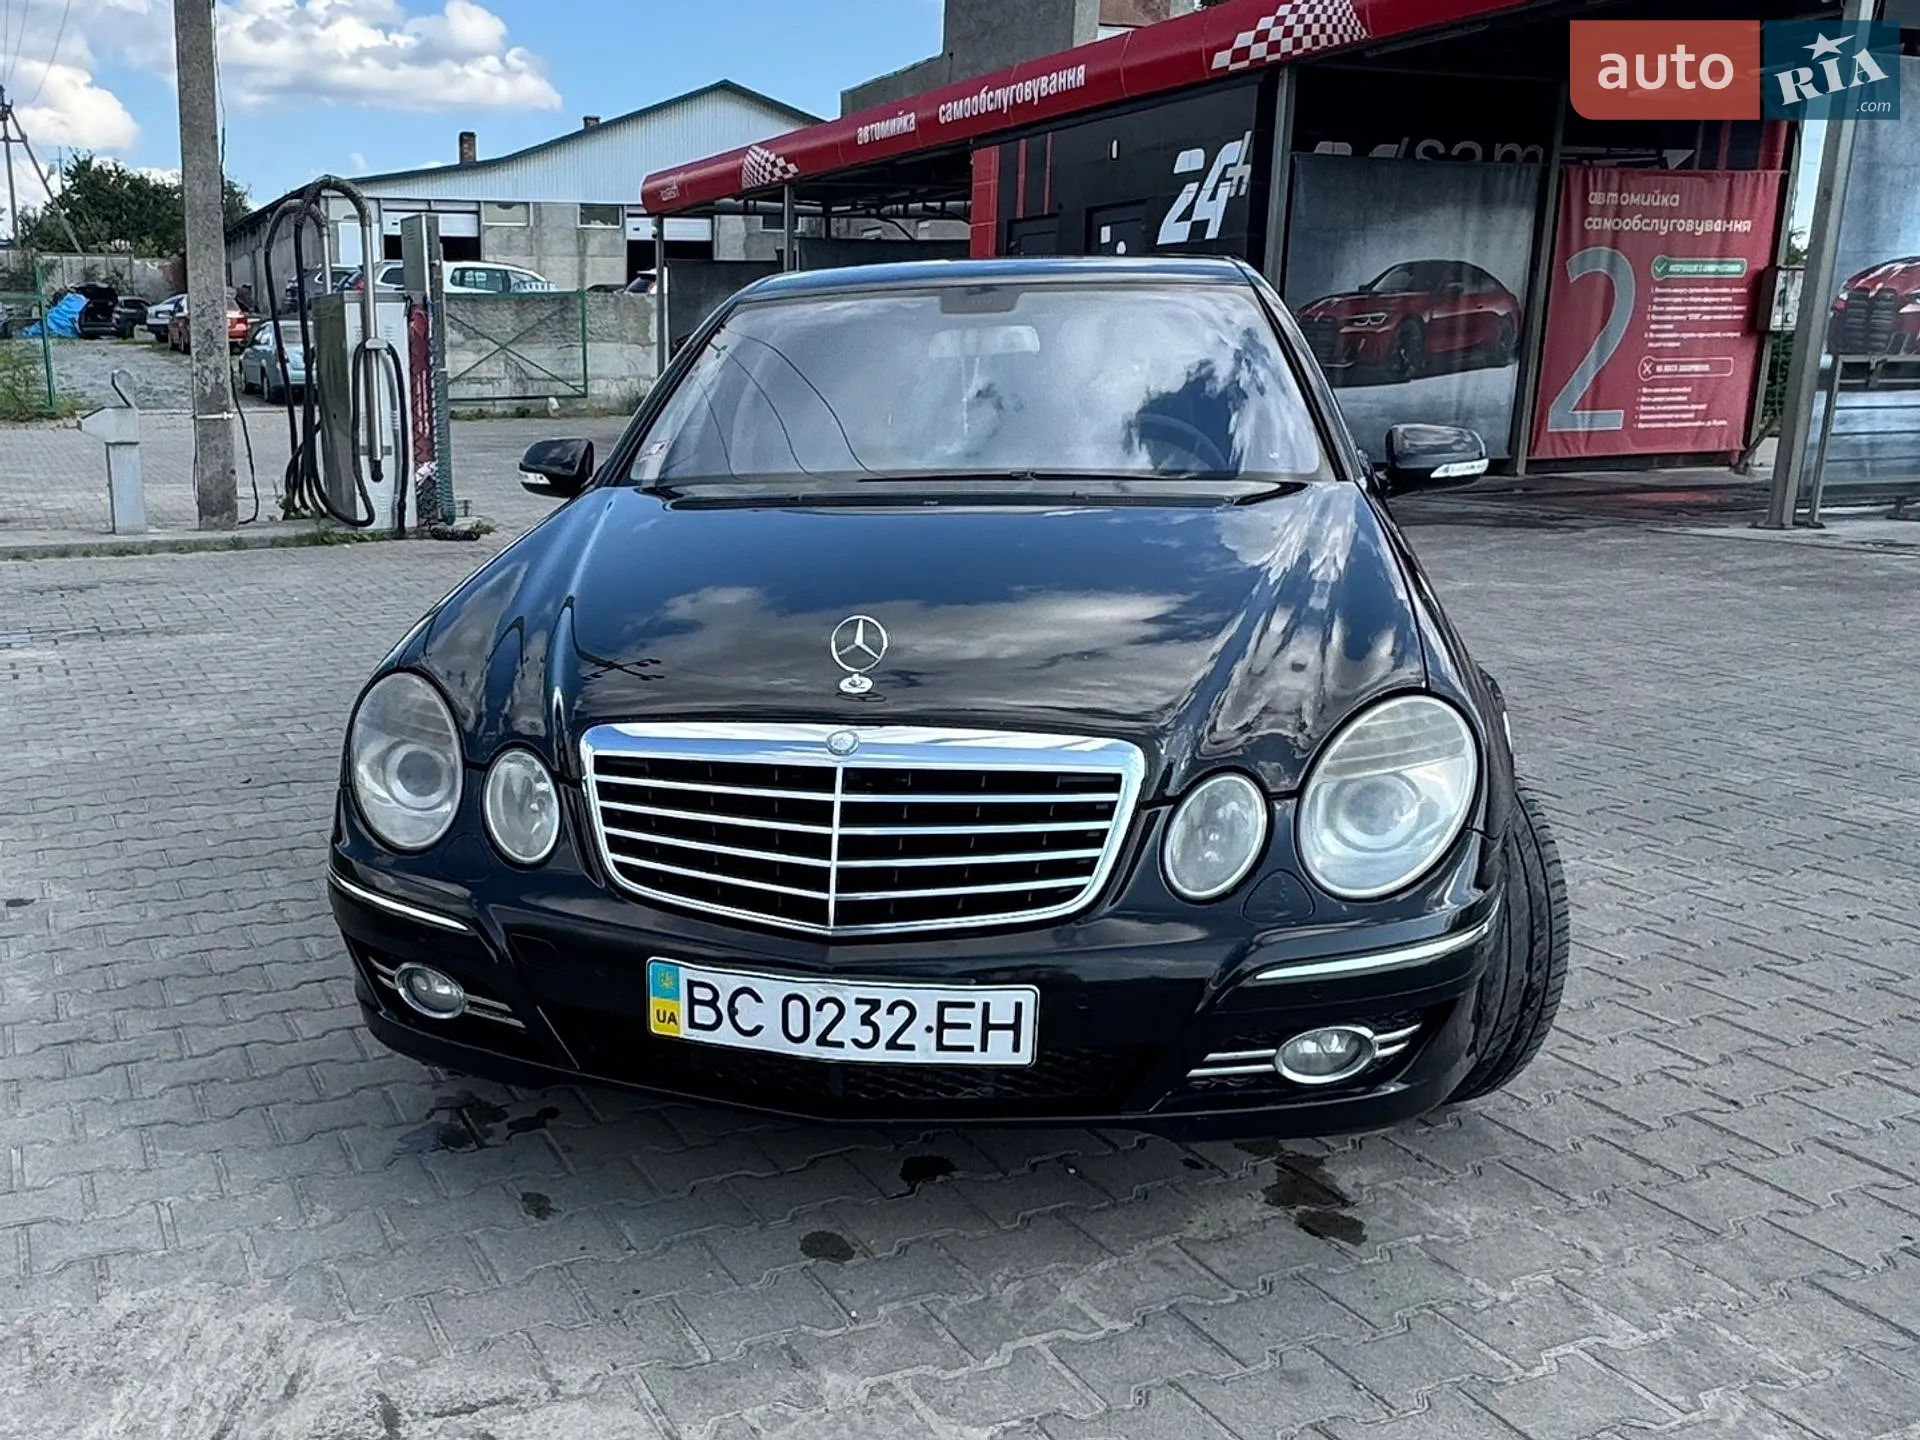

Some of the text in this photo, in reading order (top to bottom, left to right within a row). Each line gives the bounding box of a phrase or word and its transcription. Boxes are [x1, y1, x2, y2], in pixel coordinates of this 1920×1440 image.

[856, 64, 1087, 146] автомийка самообслуговування
[1588, 190, 1680, 207] автомийка
[1584, 213, 1752, 236] самообслуговування
[1547, 246, 1636, 432] 2
[656, 1009, 678, 1026] UA
[687, 979, 1023, 1053] BC 0232 EH
